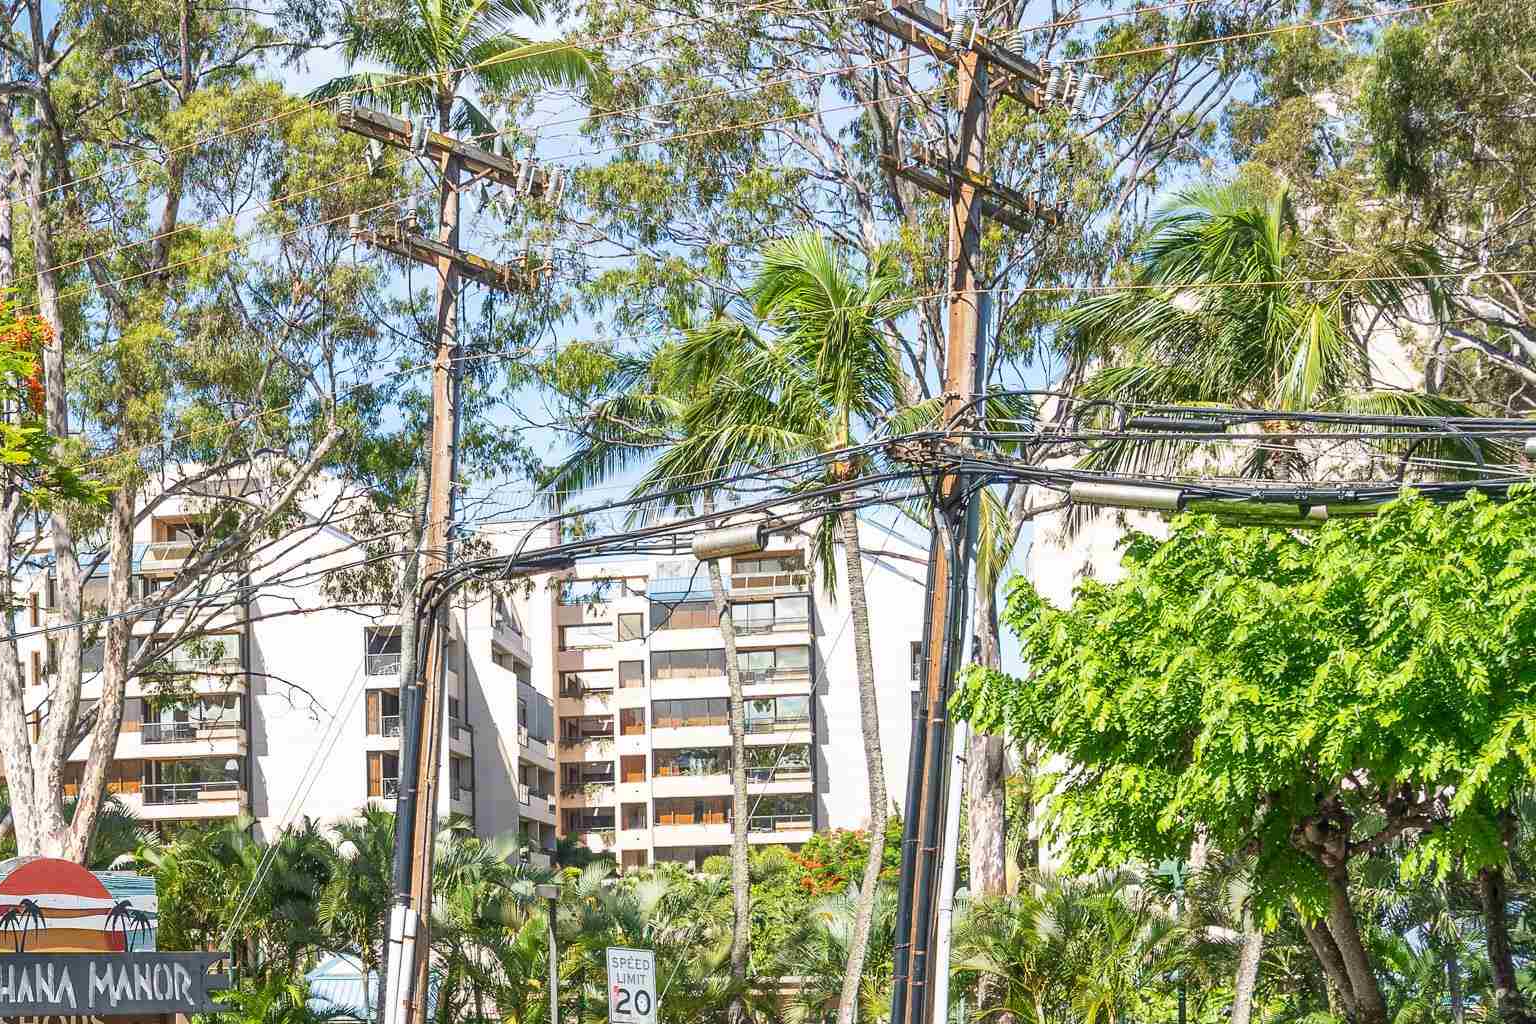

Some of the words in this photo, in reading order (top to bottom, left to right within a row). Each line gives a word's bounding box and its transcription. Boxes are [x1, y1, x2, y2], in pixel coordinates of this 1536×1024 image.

[611, 957, 649, 970] SPEED
[89, 960, 195, 1009] MANOR
[617, 972, 646, 985] LIMIT
[615, 988, 651, 1016] 20
